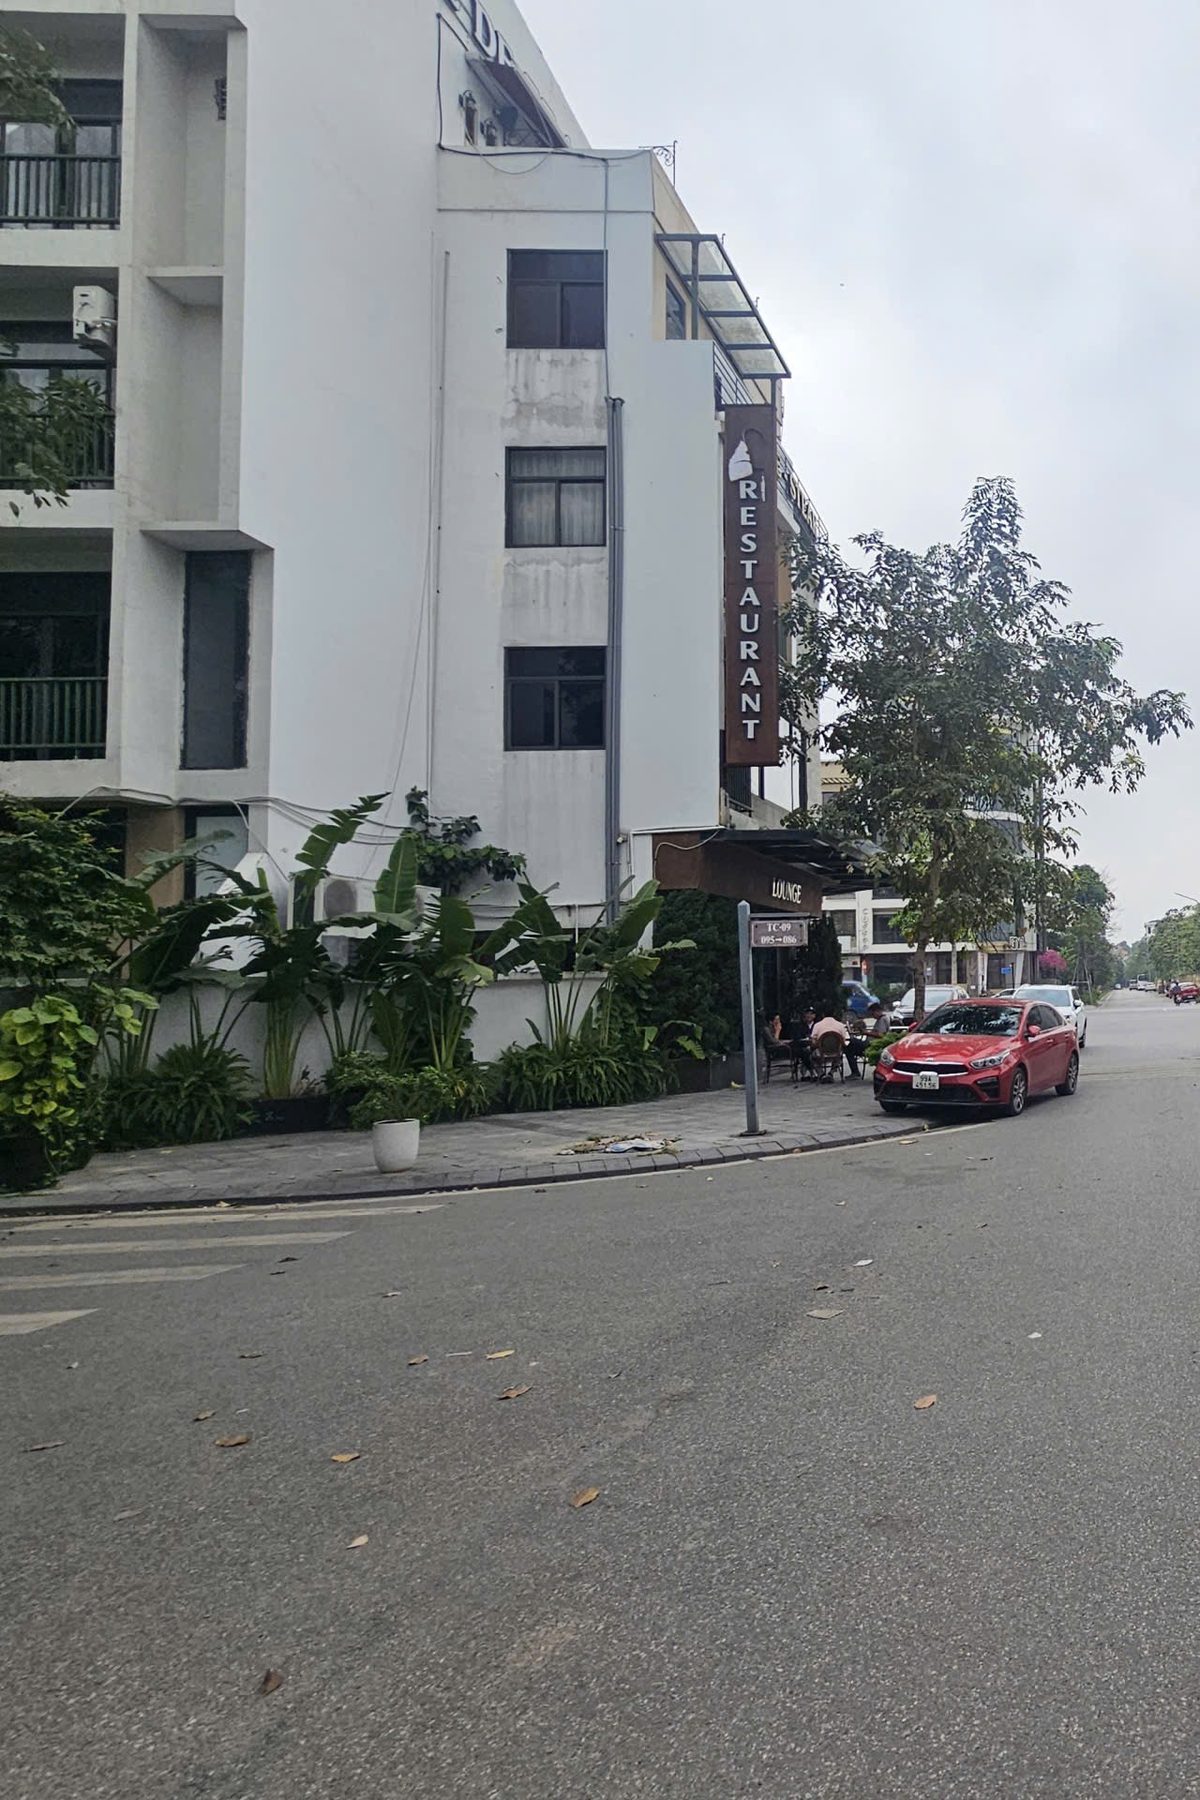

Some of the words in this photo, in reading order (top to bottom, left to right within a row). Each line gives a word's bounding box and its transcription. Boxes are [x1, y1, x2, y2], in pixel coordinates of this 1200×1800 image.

[739, 480, 761, 739] RESTAURANT
[772, 879, 802, 904] LOUNGE
[767, 923, 792, 932] TC-09
